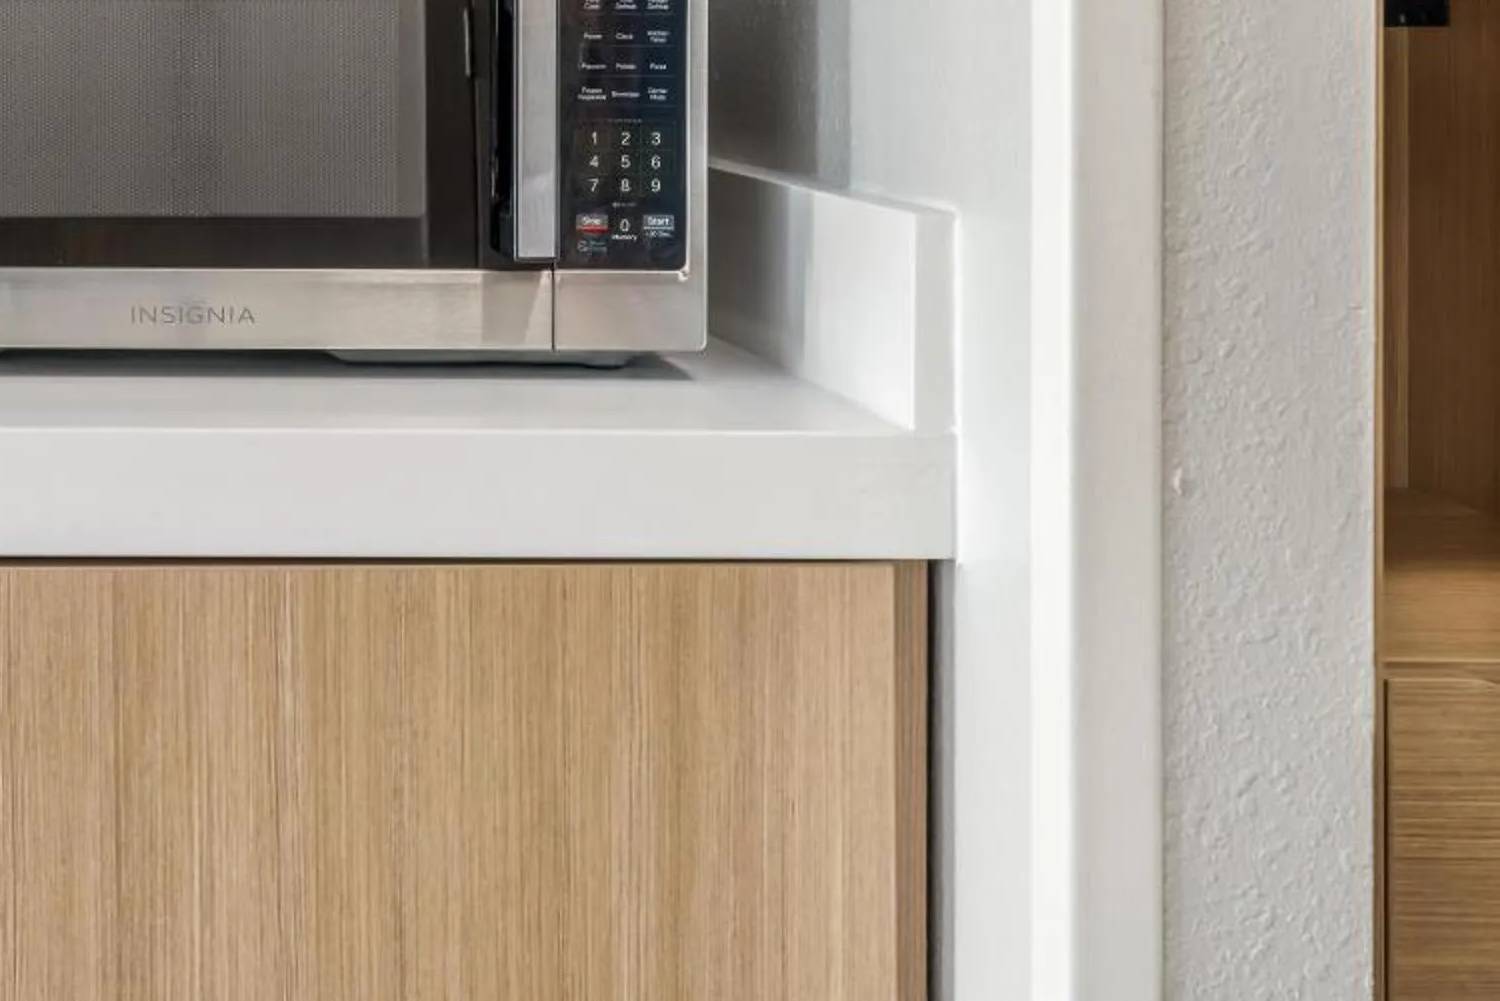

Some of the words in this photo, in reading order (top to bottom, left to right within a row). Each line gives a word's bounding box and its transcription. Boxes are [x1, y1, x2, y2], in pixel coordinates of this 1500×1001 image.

[591, 131, 598, 145] 1
[621, 131, 631, 146] 2
[651, 131, 661, 146] 3
[589, 155, 599, 168] 4
[621, 154, 631, 168] 5
[651, 154, 661, 169] 6
[588, 178, 599, 192] 7
[621, 178, 632, 192] 8
[651, 178, 661, 192] 9
[620, 218, 630, 232] 0
[647, 215, 669, 226] Start
[131, 305, 254, 324] INSIGNIA
